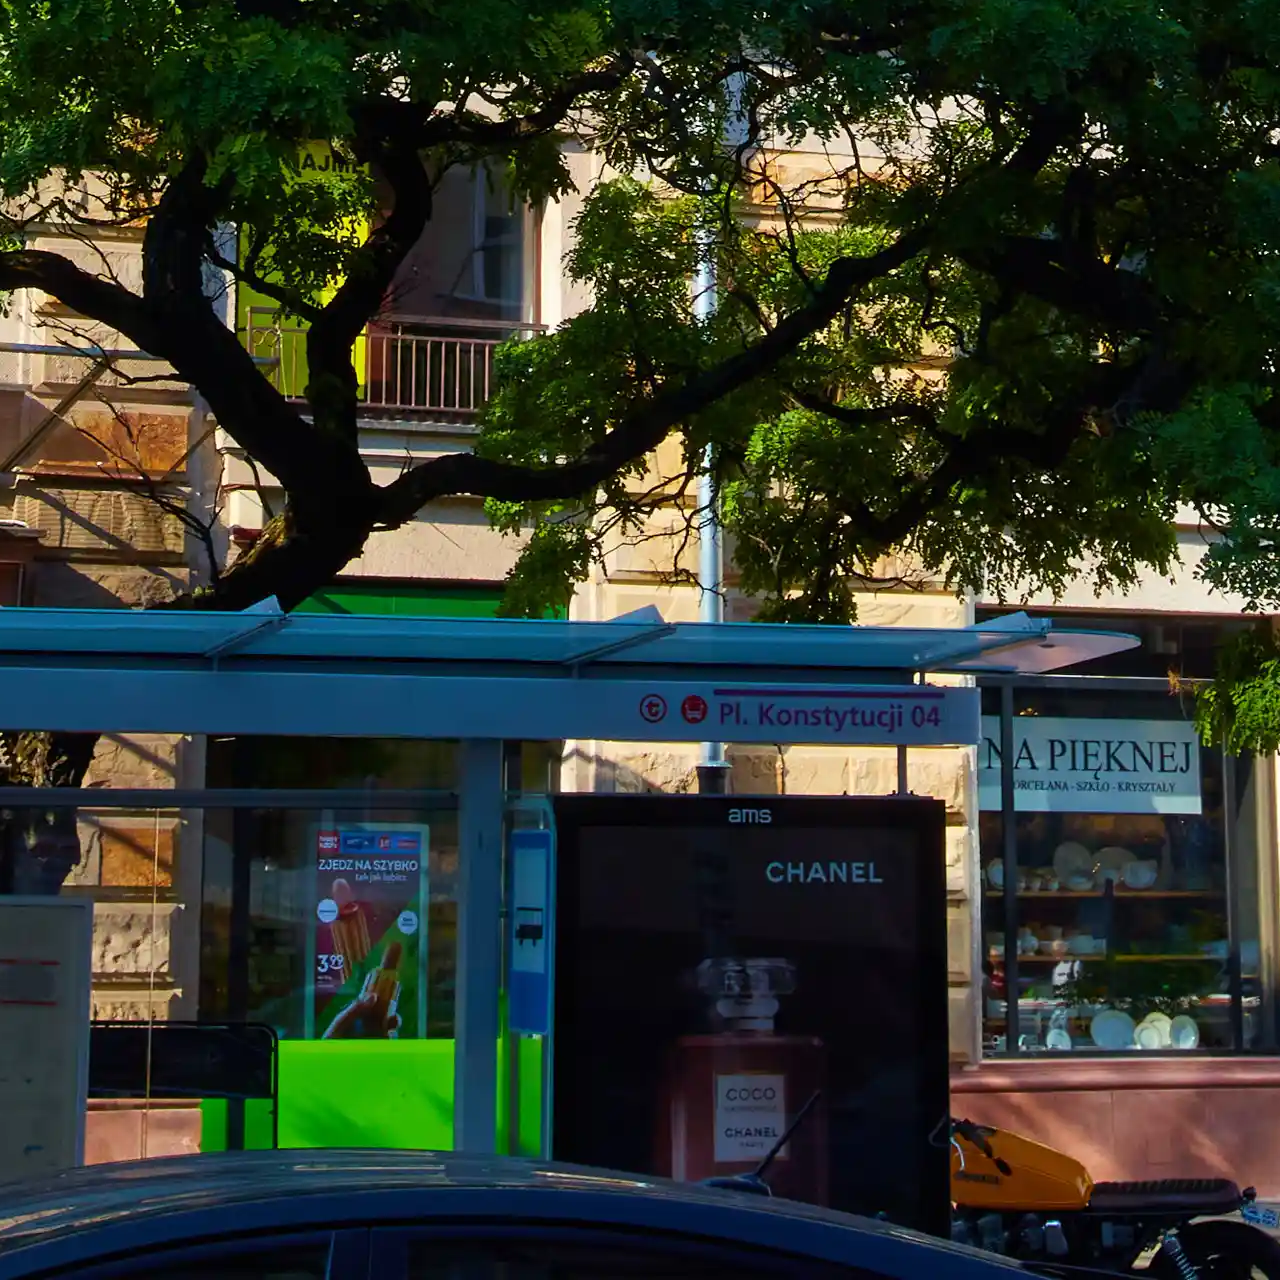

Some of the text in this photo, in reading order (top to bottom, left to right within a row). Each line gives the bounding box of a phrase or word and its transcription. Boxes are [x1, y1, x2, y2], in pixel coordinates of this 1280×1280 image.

[719, 702, 941, 733] Pl. Konstytucji 04
[984, 738, 1193, 780] NA PIĘKNEJ
[1013, 780, 1069, 792] ORCELANA
[728, 808, 772, 824] ams
[318, 859, 419, 872] ZJEDZ NA SZYBKO
[765, 861, 884, 884] CHANEL
[725, 1087, 776, 1101] COCO
[724, 1126, 780, 1139] CHANEL
